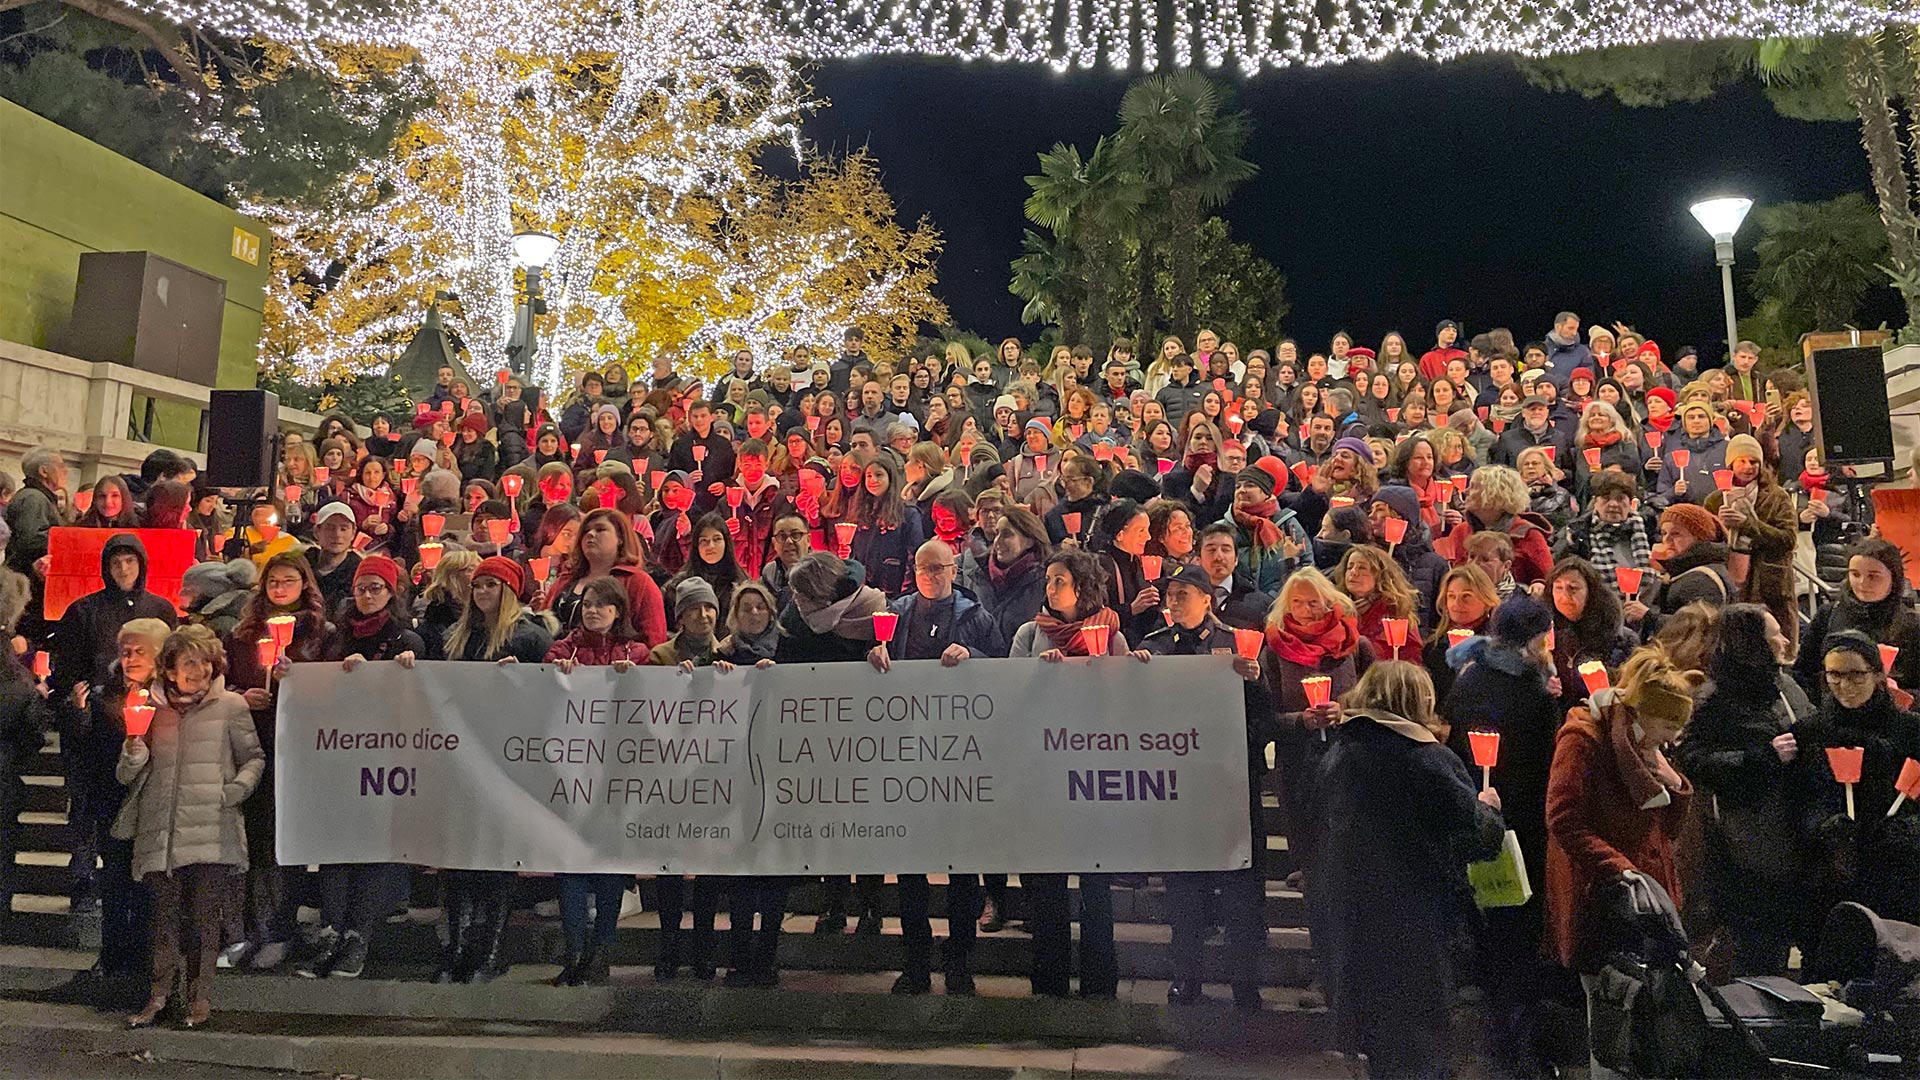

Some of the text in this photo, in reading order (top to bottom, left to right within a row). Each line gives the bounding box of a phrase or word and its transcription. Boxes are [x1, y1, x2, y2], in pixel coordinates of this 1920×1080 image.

[565, 698, 739, 725] NETZWERK
[780, 693, 994, 724] RETE CONTRO
[315, 727, 460, 751] Merano dice
[503, 735, 736, 765] GEGEN GEWALT
[778, 734, 982, 764] LA VIOLENZA
[1043, 727, 1201, 757] Meran sagt
[359, 766, 417, 797] NO!
[549, 777, 732, 805] AN FRAUEN
[775, 775, 995, 805] SULLE DONNE
[1067, 769, 1179, 802] NEIN!
[625, 822, 730, 839] Stadt Meran
[773, 821, 907, 840] Città di Merano
